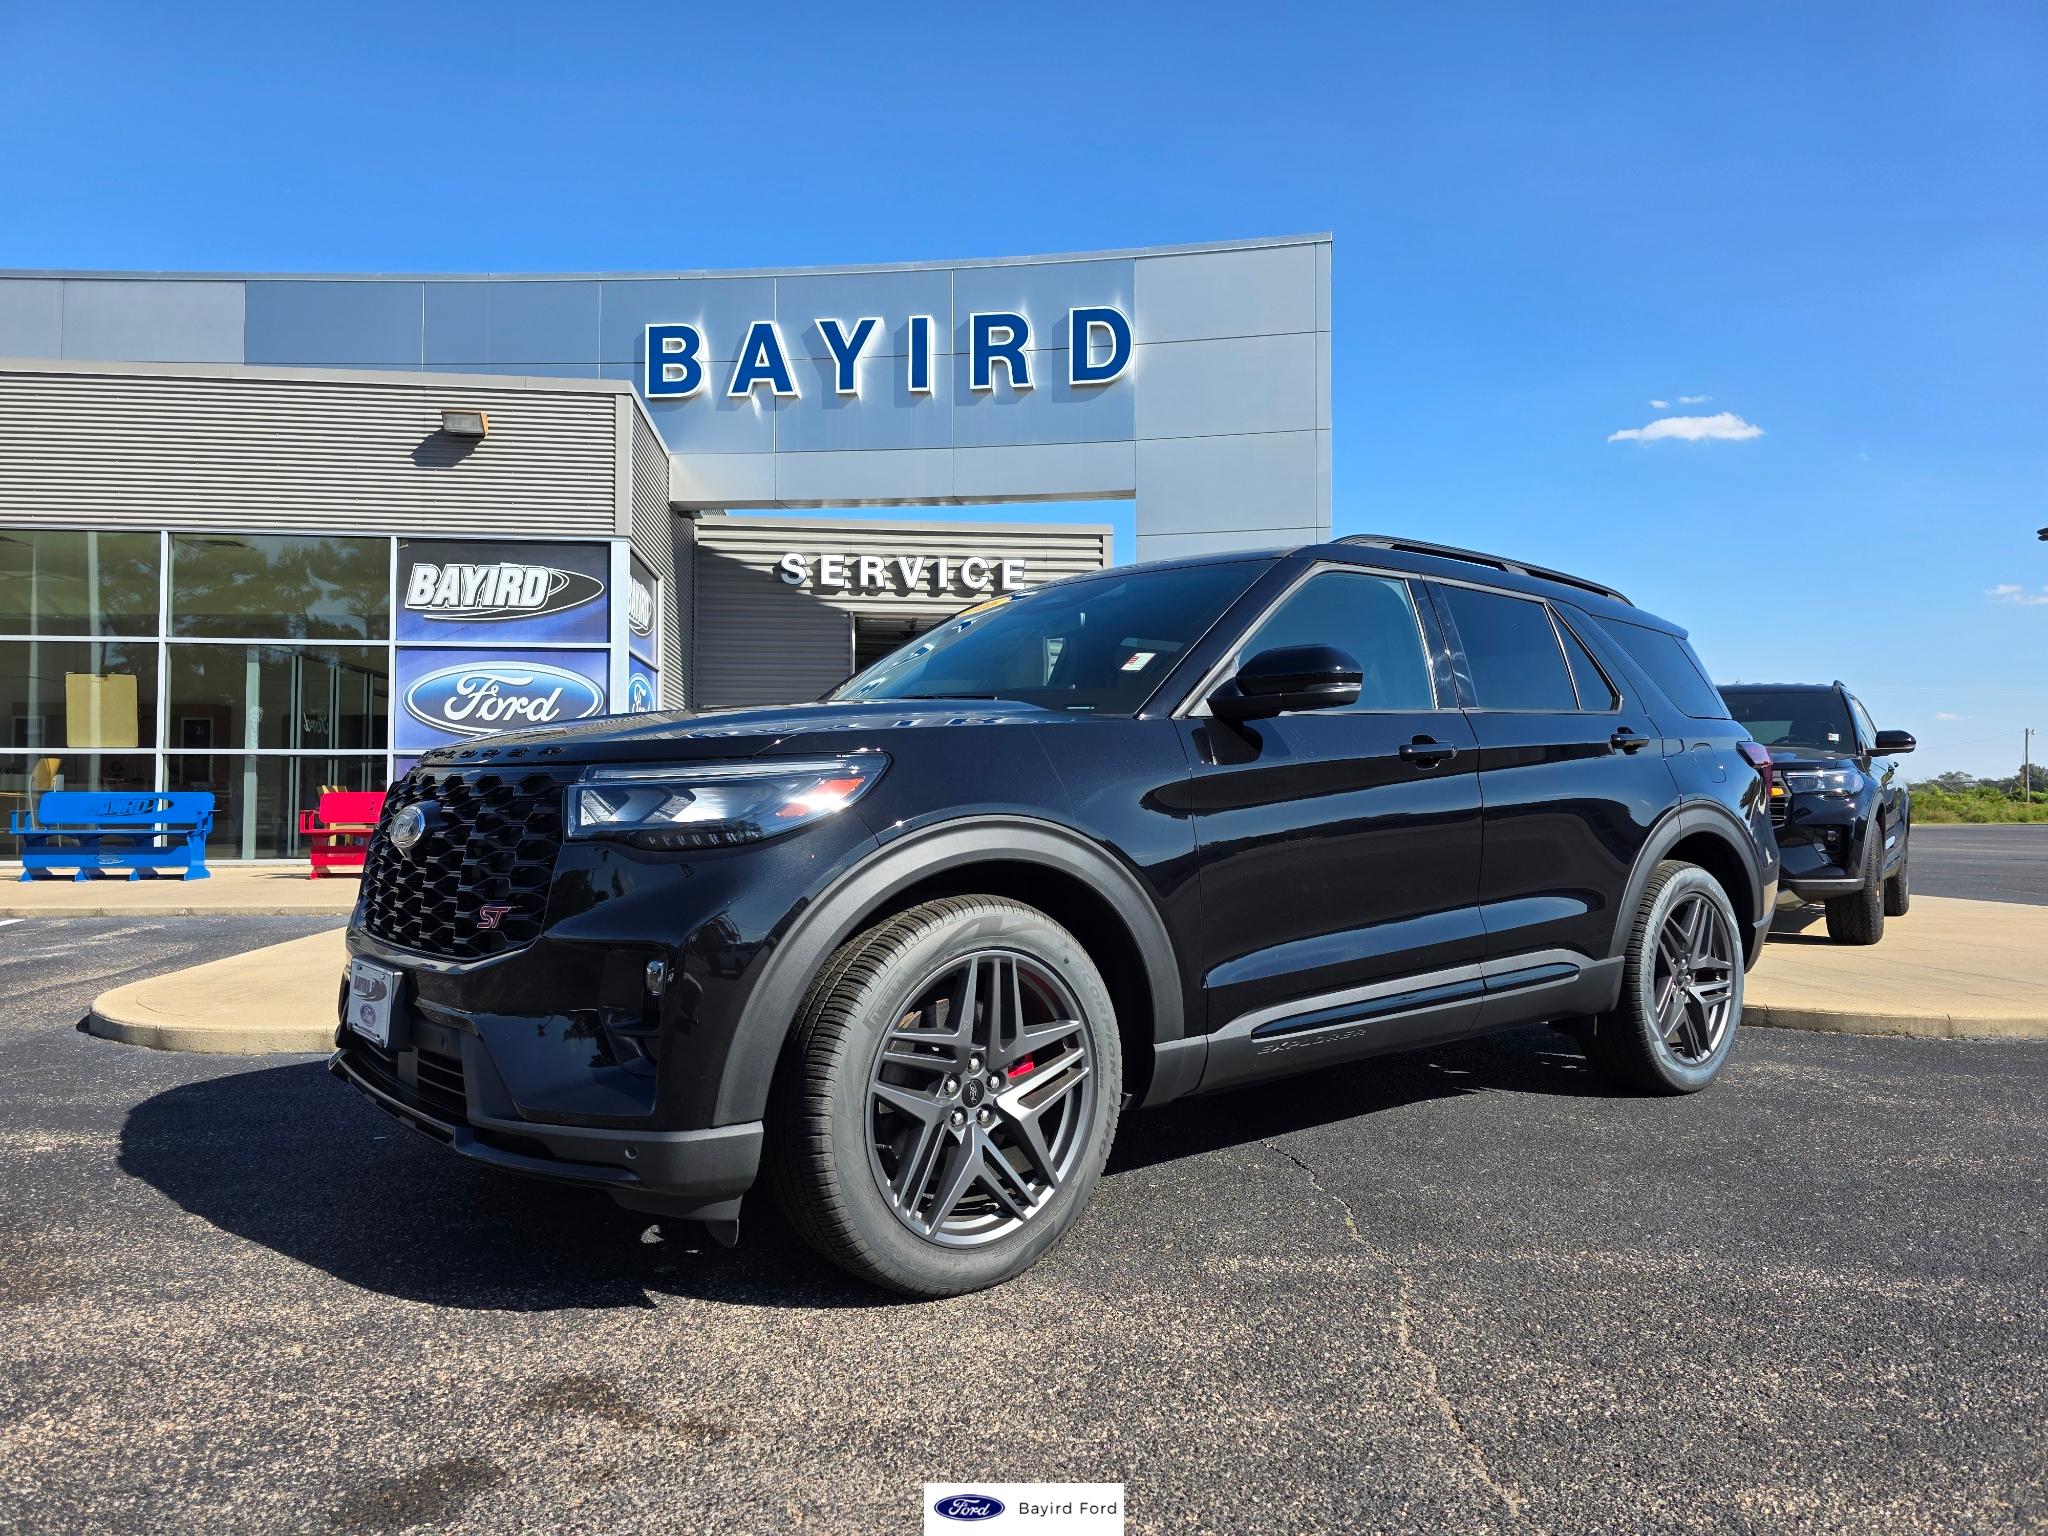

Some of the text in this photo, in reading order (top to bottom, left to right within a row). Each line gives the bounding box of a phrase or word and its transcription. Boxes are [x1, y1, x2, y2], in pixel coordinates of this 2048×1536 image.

[644, 305, 1135, 399] BAYIRD
[405, 563, 552, 610] BAYIRD
[780, 552, 1026, 590] SERVICE
[443, 672, 564, 722] Ford
[476, 904, 512, 929] ST
[1257, 1028, 1367, 1055] EXPLORER
